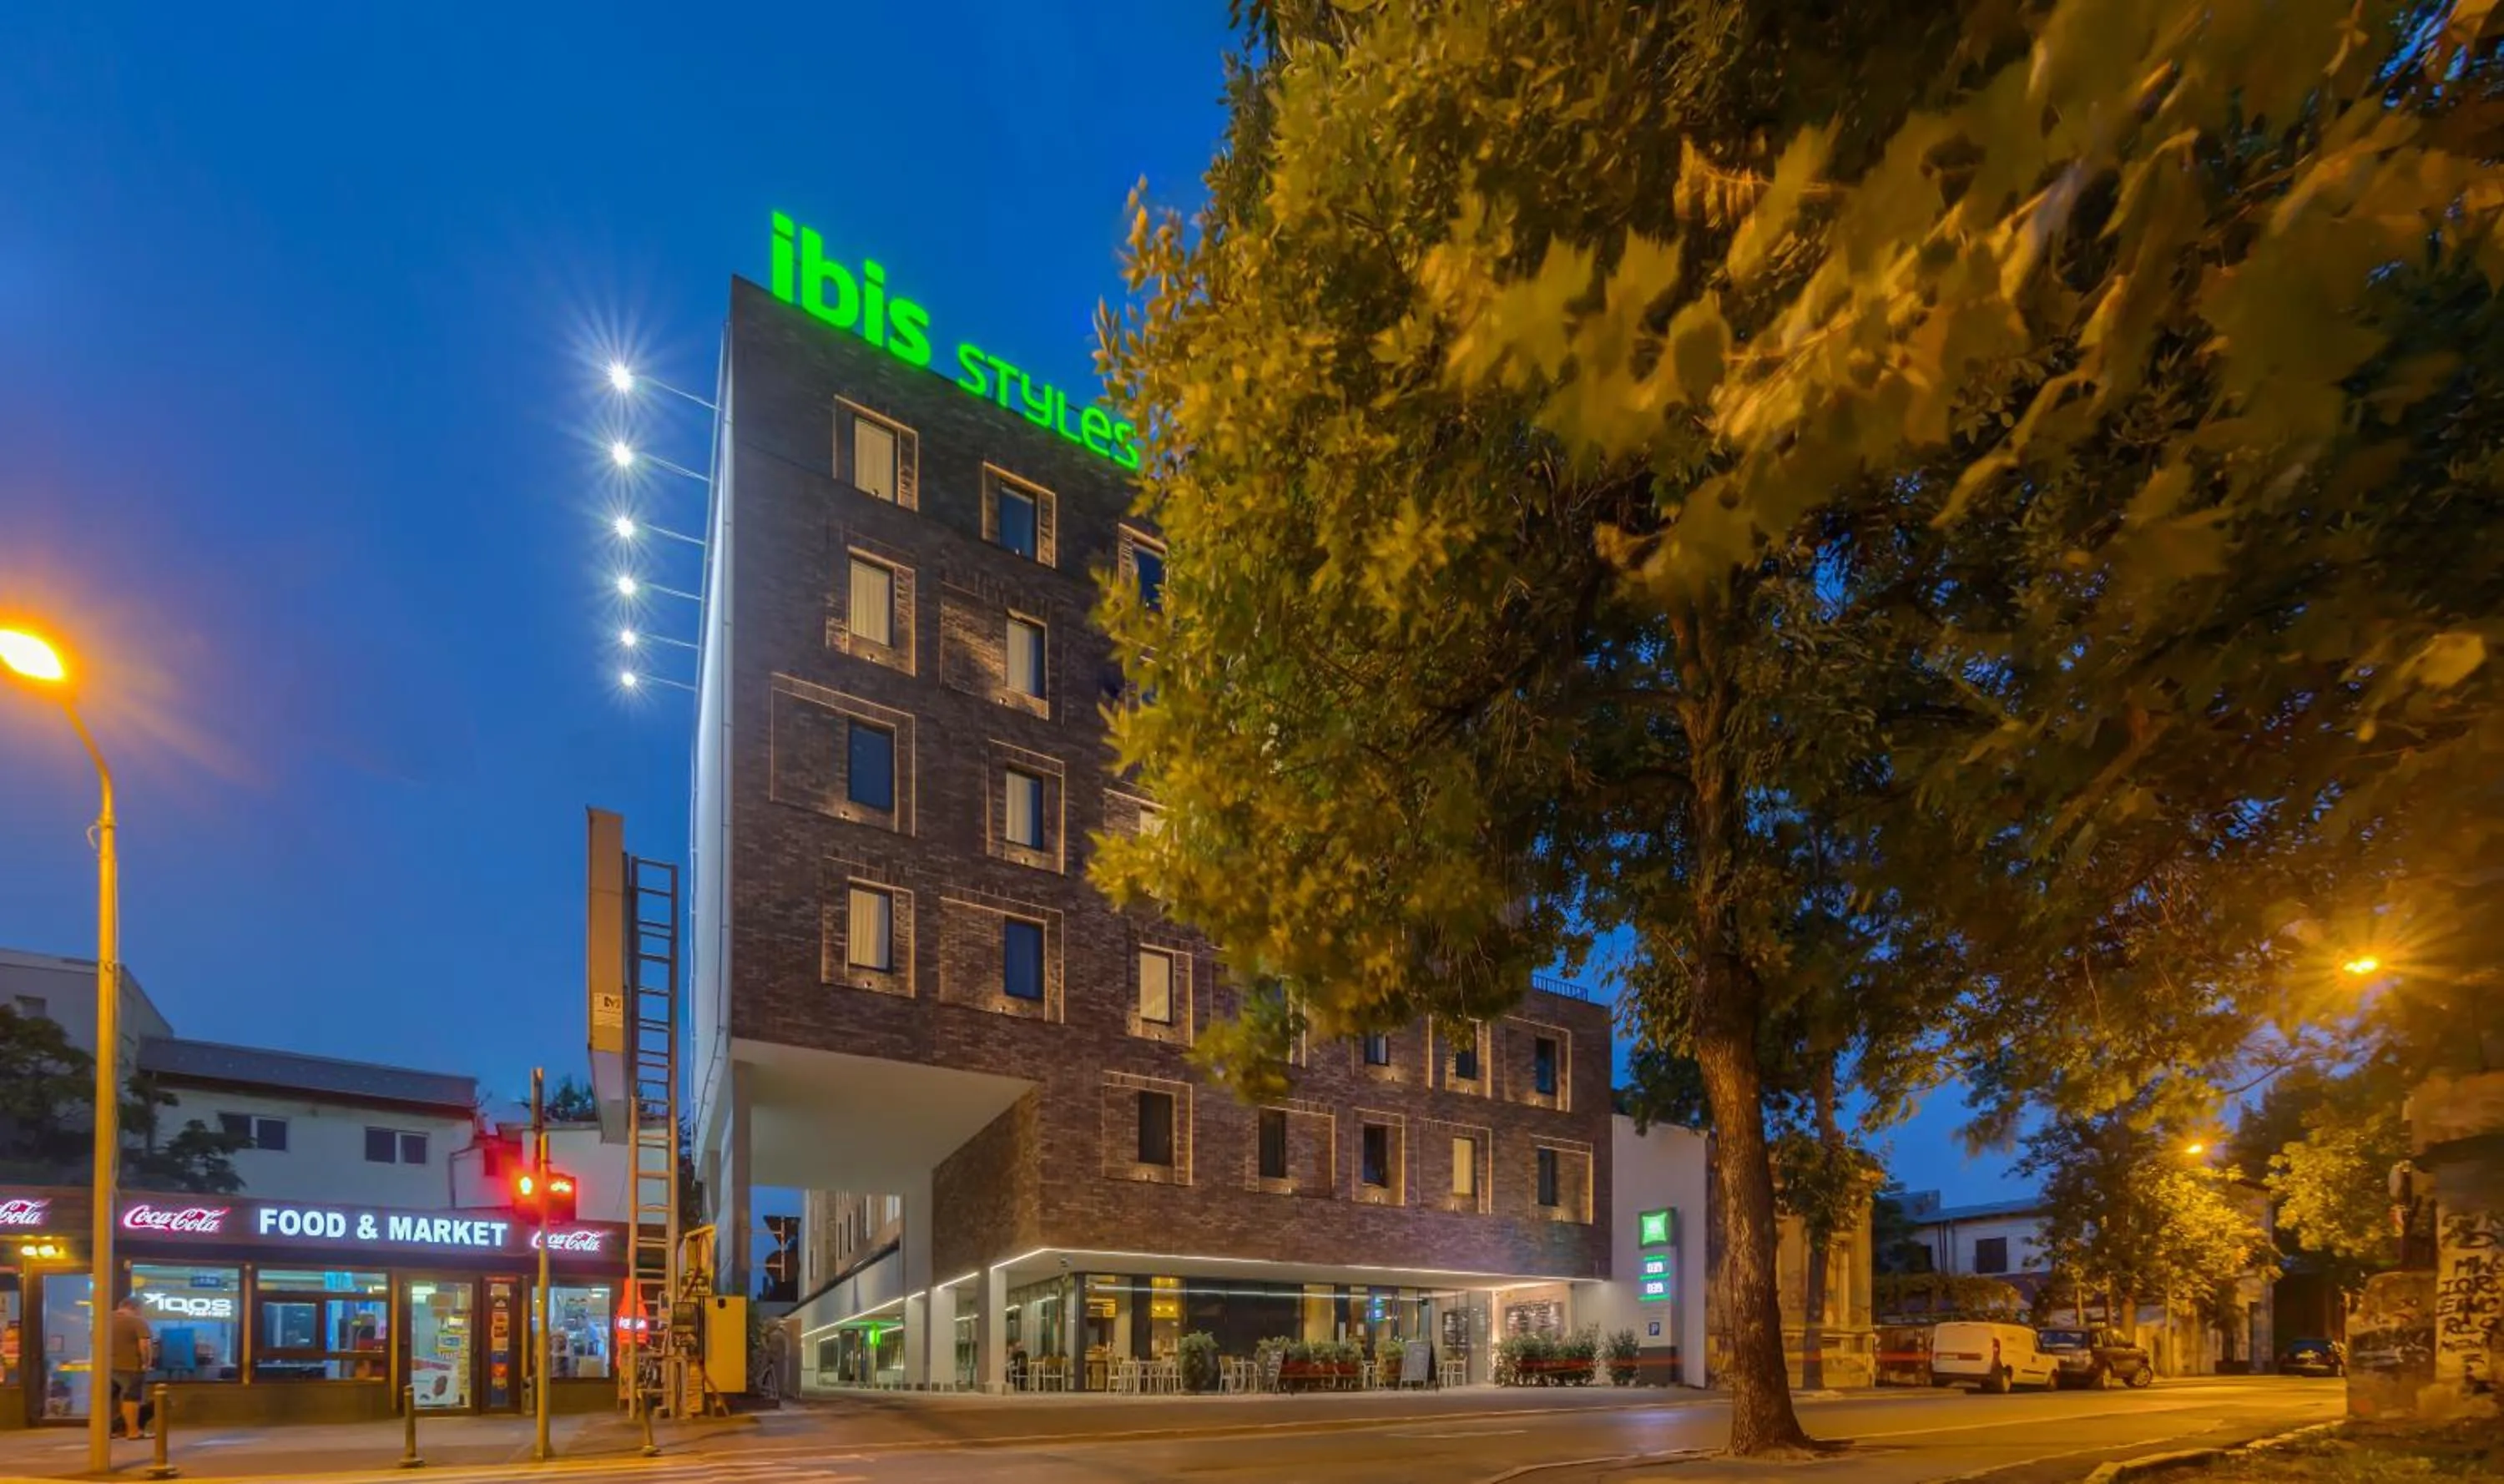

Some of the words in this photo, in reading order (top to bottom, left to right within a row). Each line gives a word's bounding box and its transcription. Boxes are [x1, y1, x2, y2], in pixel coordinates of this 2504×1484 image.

[771, 210, 931, 368] ibis
[123, 1204, 229, 1233] Coca-Cola
[259, 1209, 346, 1239] FOOD
[356, 1214, 378, 1240] &
[388, 1215, 508, 1247] MARKET
